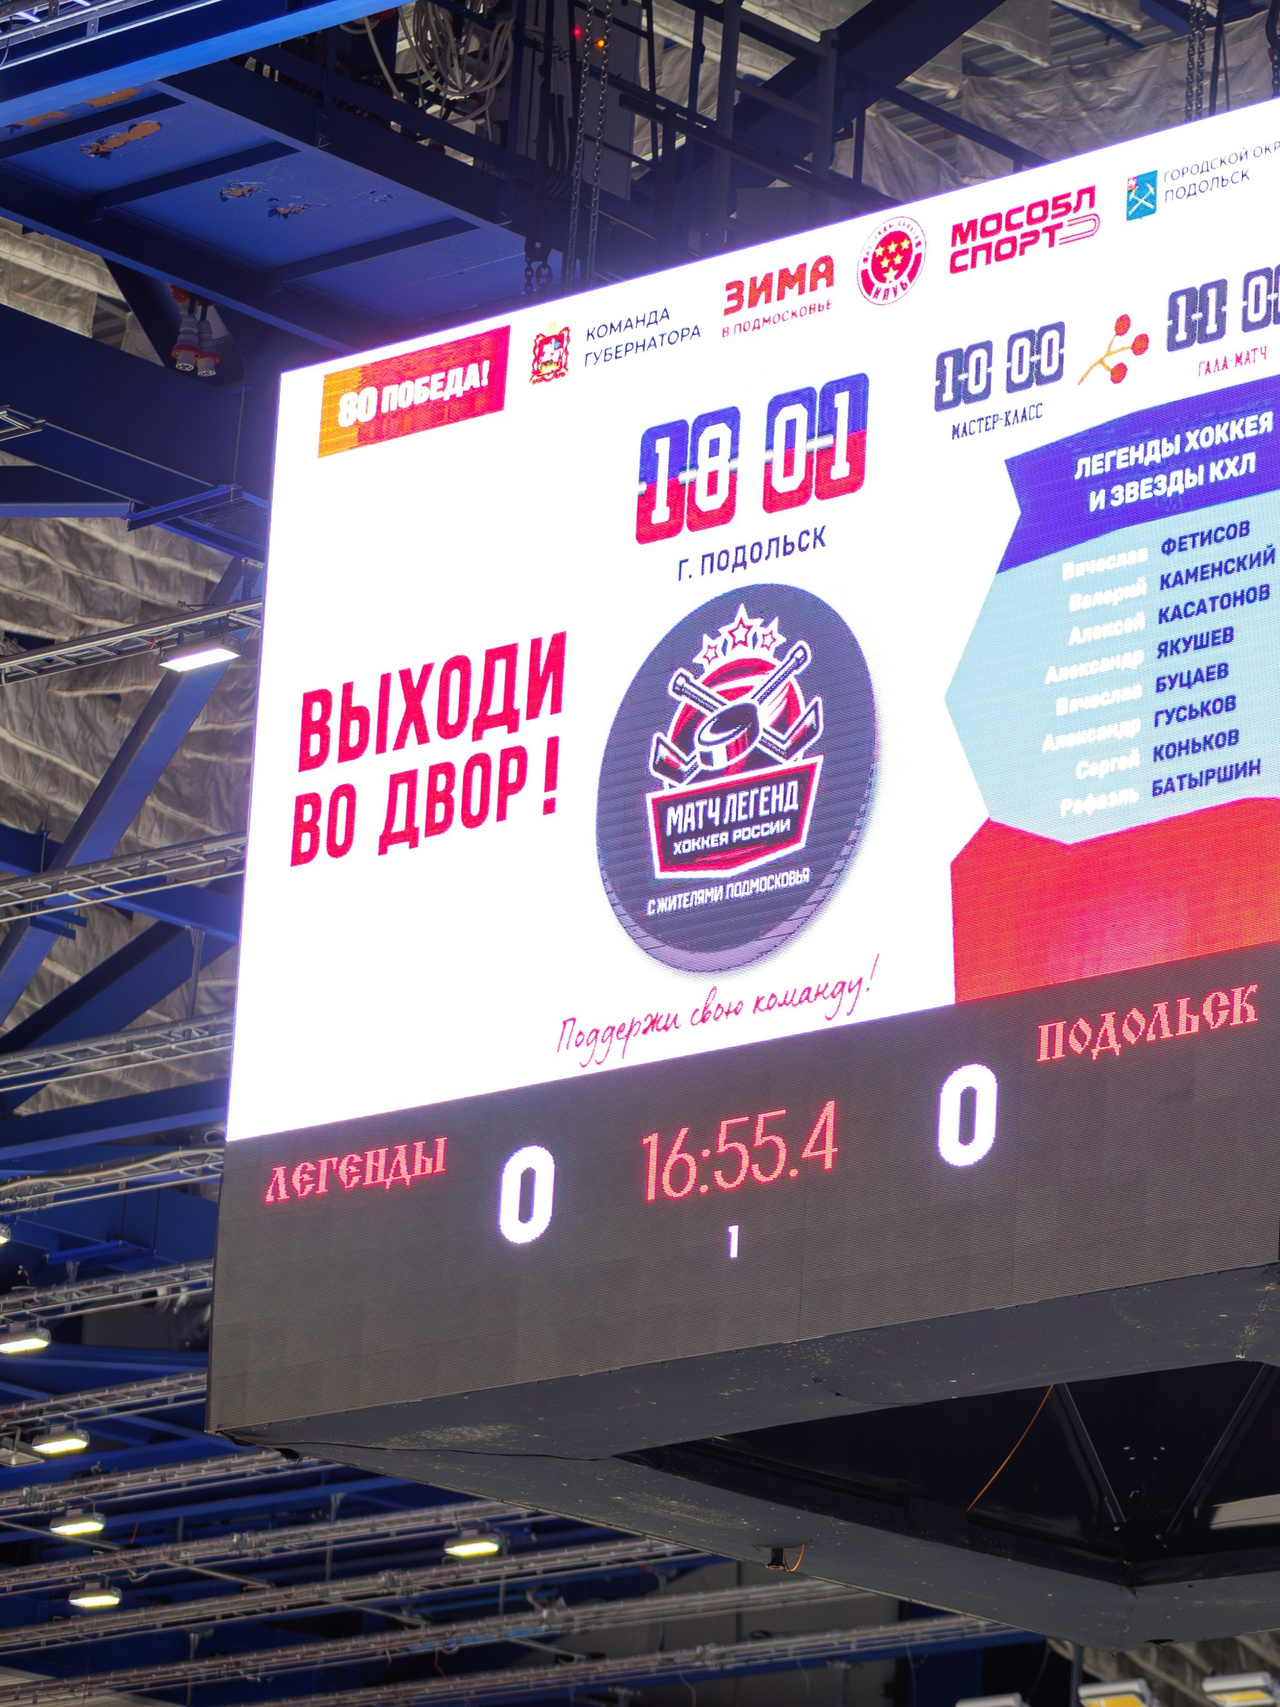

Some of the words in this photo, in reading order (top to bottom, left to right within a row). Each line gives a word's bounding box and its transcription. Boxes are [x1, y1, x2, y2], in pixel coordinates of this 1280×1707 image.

[1164, 147, 1248, 183] ГОРОДСКОЙ
[1165, 168, 1250, 203] ПОДОЛЬСК
[949, 222, 1064, 275] СПОРТ
[723, 254, 836, 316] ЗИМА
[585, 306, 671, 342] КОМАНДА
[721, 326, 730, 338] В
[733, 299, 832, 335] ПОДМОСКОВЬЕ
[584, 324, 702, 368] ГУБЕРНАТОРА
[1198, 347, 1268, 377] ГАЛА-МАТЧ
[337, 386, 379, 428] 80
[381, 360, 490, 413] ПОБЕДА!
[952, 403, 1043, 440] МАСТЕР-КЛАСС
[644, 414, 736, 534] 18
[767, 380, 861, 502] 01
[1075, 435, 1181, 480] ЛЕГЕНДЫ
[1185, 411, 1274, 452] ХОККЕЯ
[1089, 491, 1105, 512] И
[1111, 464, 1204, 508] ЗВЕЗДЫ
[1210, 452, 1256, 483] КХЛ
[677, 558, 693, 581] Г.
[700, 524, 827, 577] ПОДОЛЬСК
[1161, 520, 1251, 555] ФЕТИСОВ
[1160, 544, 1276, 590] КАМЕНСКИЙ
[1158, 584, 1270, 624] КАСАТОНОВ
[1157, 626, 1234, 659] ЯКУШЕВ
[298, 630, 566, 772] ВЫХОДИ
[1156, 662, 1229, 693] БУЦАЕВ
[1154, 695, 1236, 728] ГУСЬКОВ
[1153, 729, 1240, 762] КОНЬКОВ
[1152, 758, 1261, 797] БАТЫРШИН
[290, 782, 357, 867] ВО
[666, 797, 721, 836] МАТЧ
[724, 780, 798, 824] ЛЕГЕНД
[673, 831, 729, 855] ХОККЕЯ
[732, 818, 791, 843] РОССИИ
[647, 899, 656, 915] С
[657, 885, 723, 914] ЖИТЕЛЯМИ
[725, 867, 811, 900] ПОДМОСКОВЬЯ
[557, 1013, 681, 1068] Поддержи
[690, 986, 744, 1026] свою
[753, 953, 880, 1021] команду!
[1037, 984, 1258, 1061] ПОДОЛЬСК
[938, 1063, 998, 1167] 0
[265, 1137, 447, 1203] ЛЕГЕНДЫ
[642, 1100, 838, 1201] 16:55.4
[499, 1145, 555, 1244] 0
[727, 1225, 739, 1258] 1
